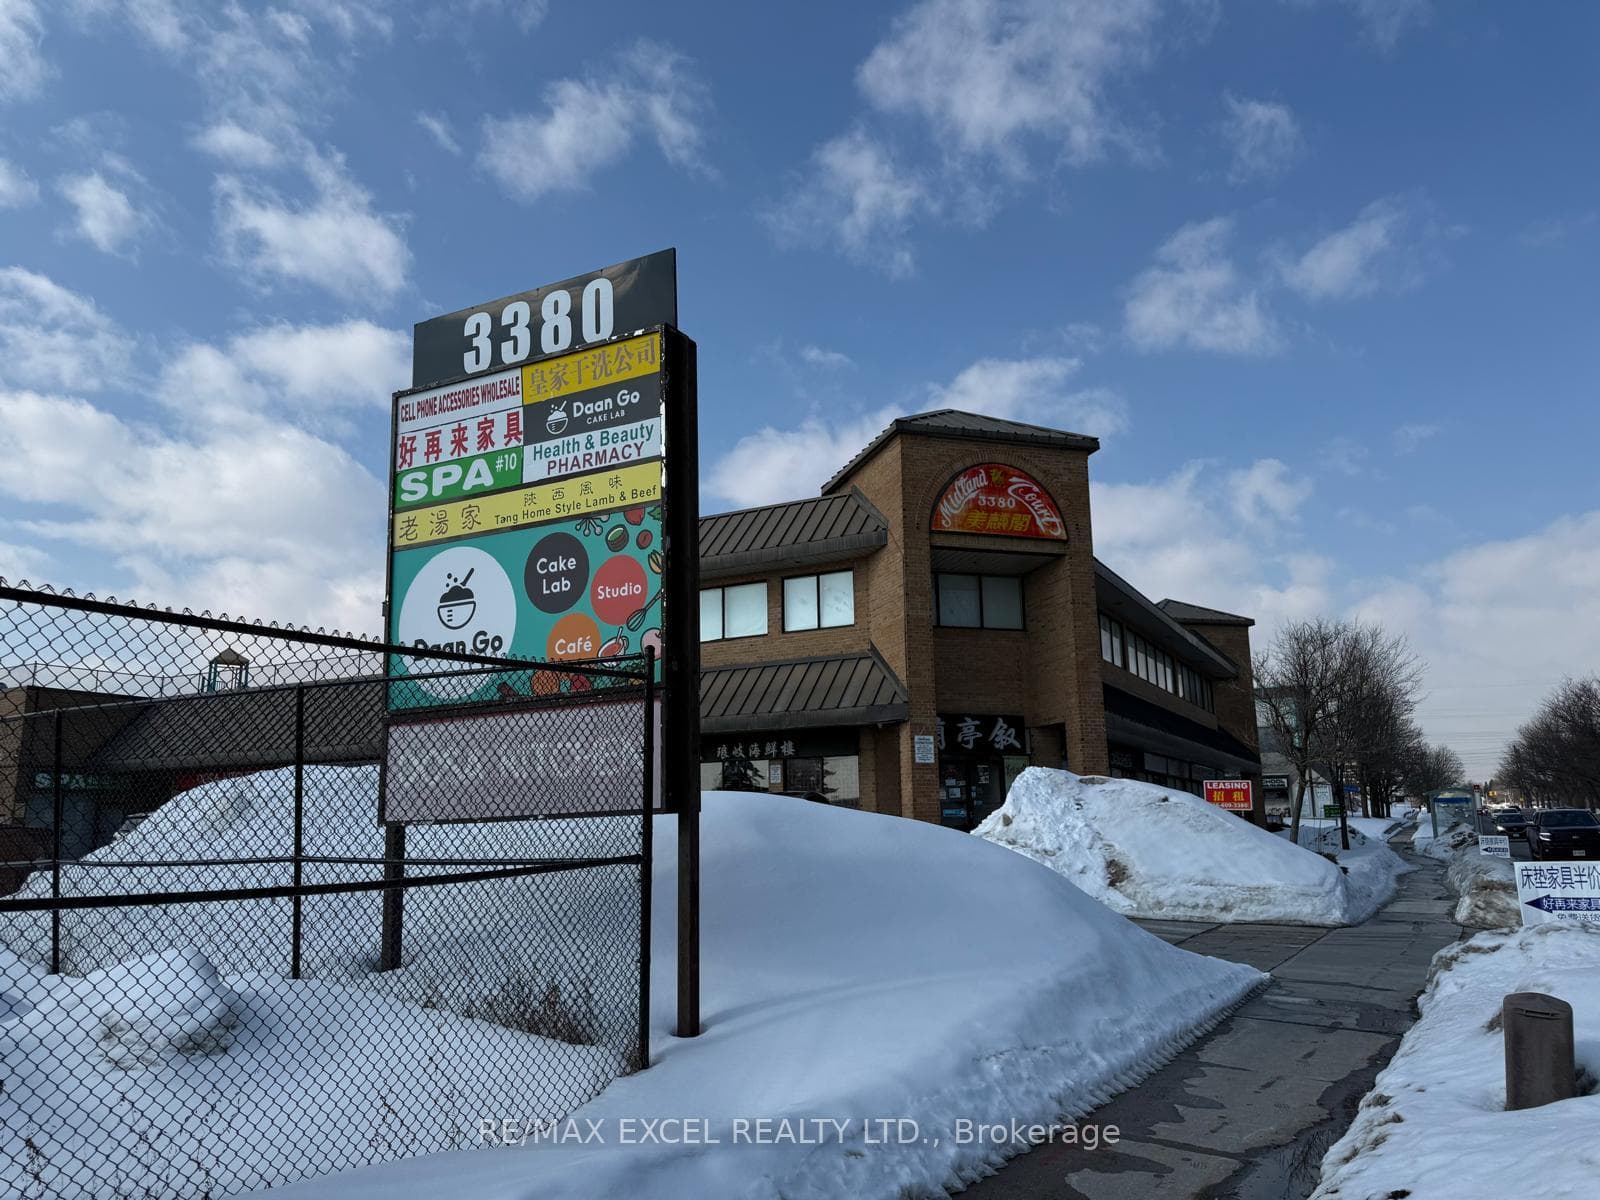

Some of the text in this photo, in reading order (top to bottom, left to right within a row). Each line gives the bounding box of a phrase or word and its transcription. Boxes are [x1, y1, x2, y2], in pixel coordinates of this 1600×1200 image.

[463, 277, 614, 375] 3380
[530, 337, 656, 398] 皇家干洗公司
[400, 376, 520, 423] CELL PHONE ACCESSORIES WHOLESALE
[572, 389, 641, 418] Daan Go
[586, 409, 625, 425] CAKE LAB
[398, 411, 523, 470] 好再来家具
[533, 423, 654, 461] Health & Beauty
[547, 441, 645, 475] PHARMACY
[400, 452, 517, 502] SPA #10
[494, 485, 657, 526] Tang Home Style Lamb & Beef
[940, 469, 1061, 536] Midland Court
[978, 495, 1016, 508] 3380
[536, 554, 577, 575] Cake
[542, 578, 571, 595] Lab
[597, 582, 642, 600] Studio
[472, 630, 504, 654] Go
[554, 635, 593, 656] Café
[1206, 782, 1249, 790] LEASING
[1520, 865, 1600, 890] 床垫家具半价
